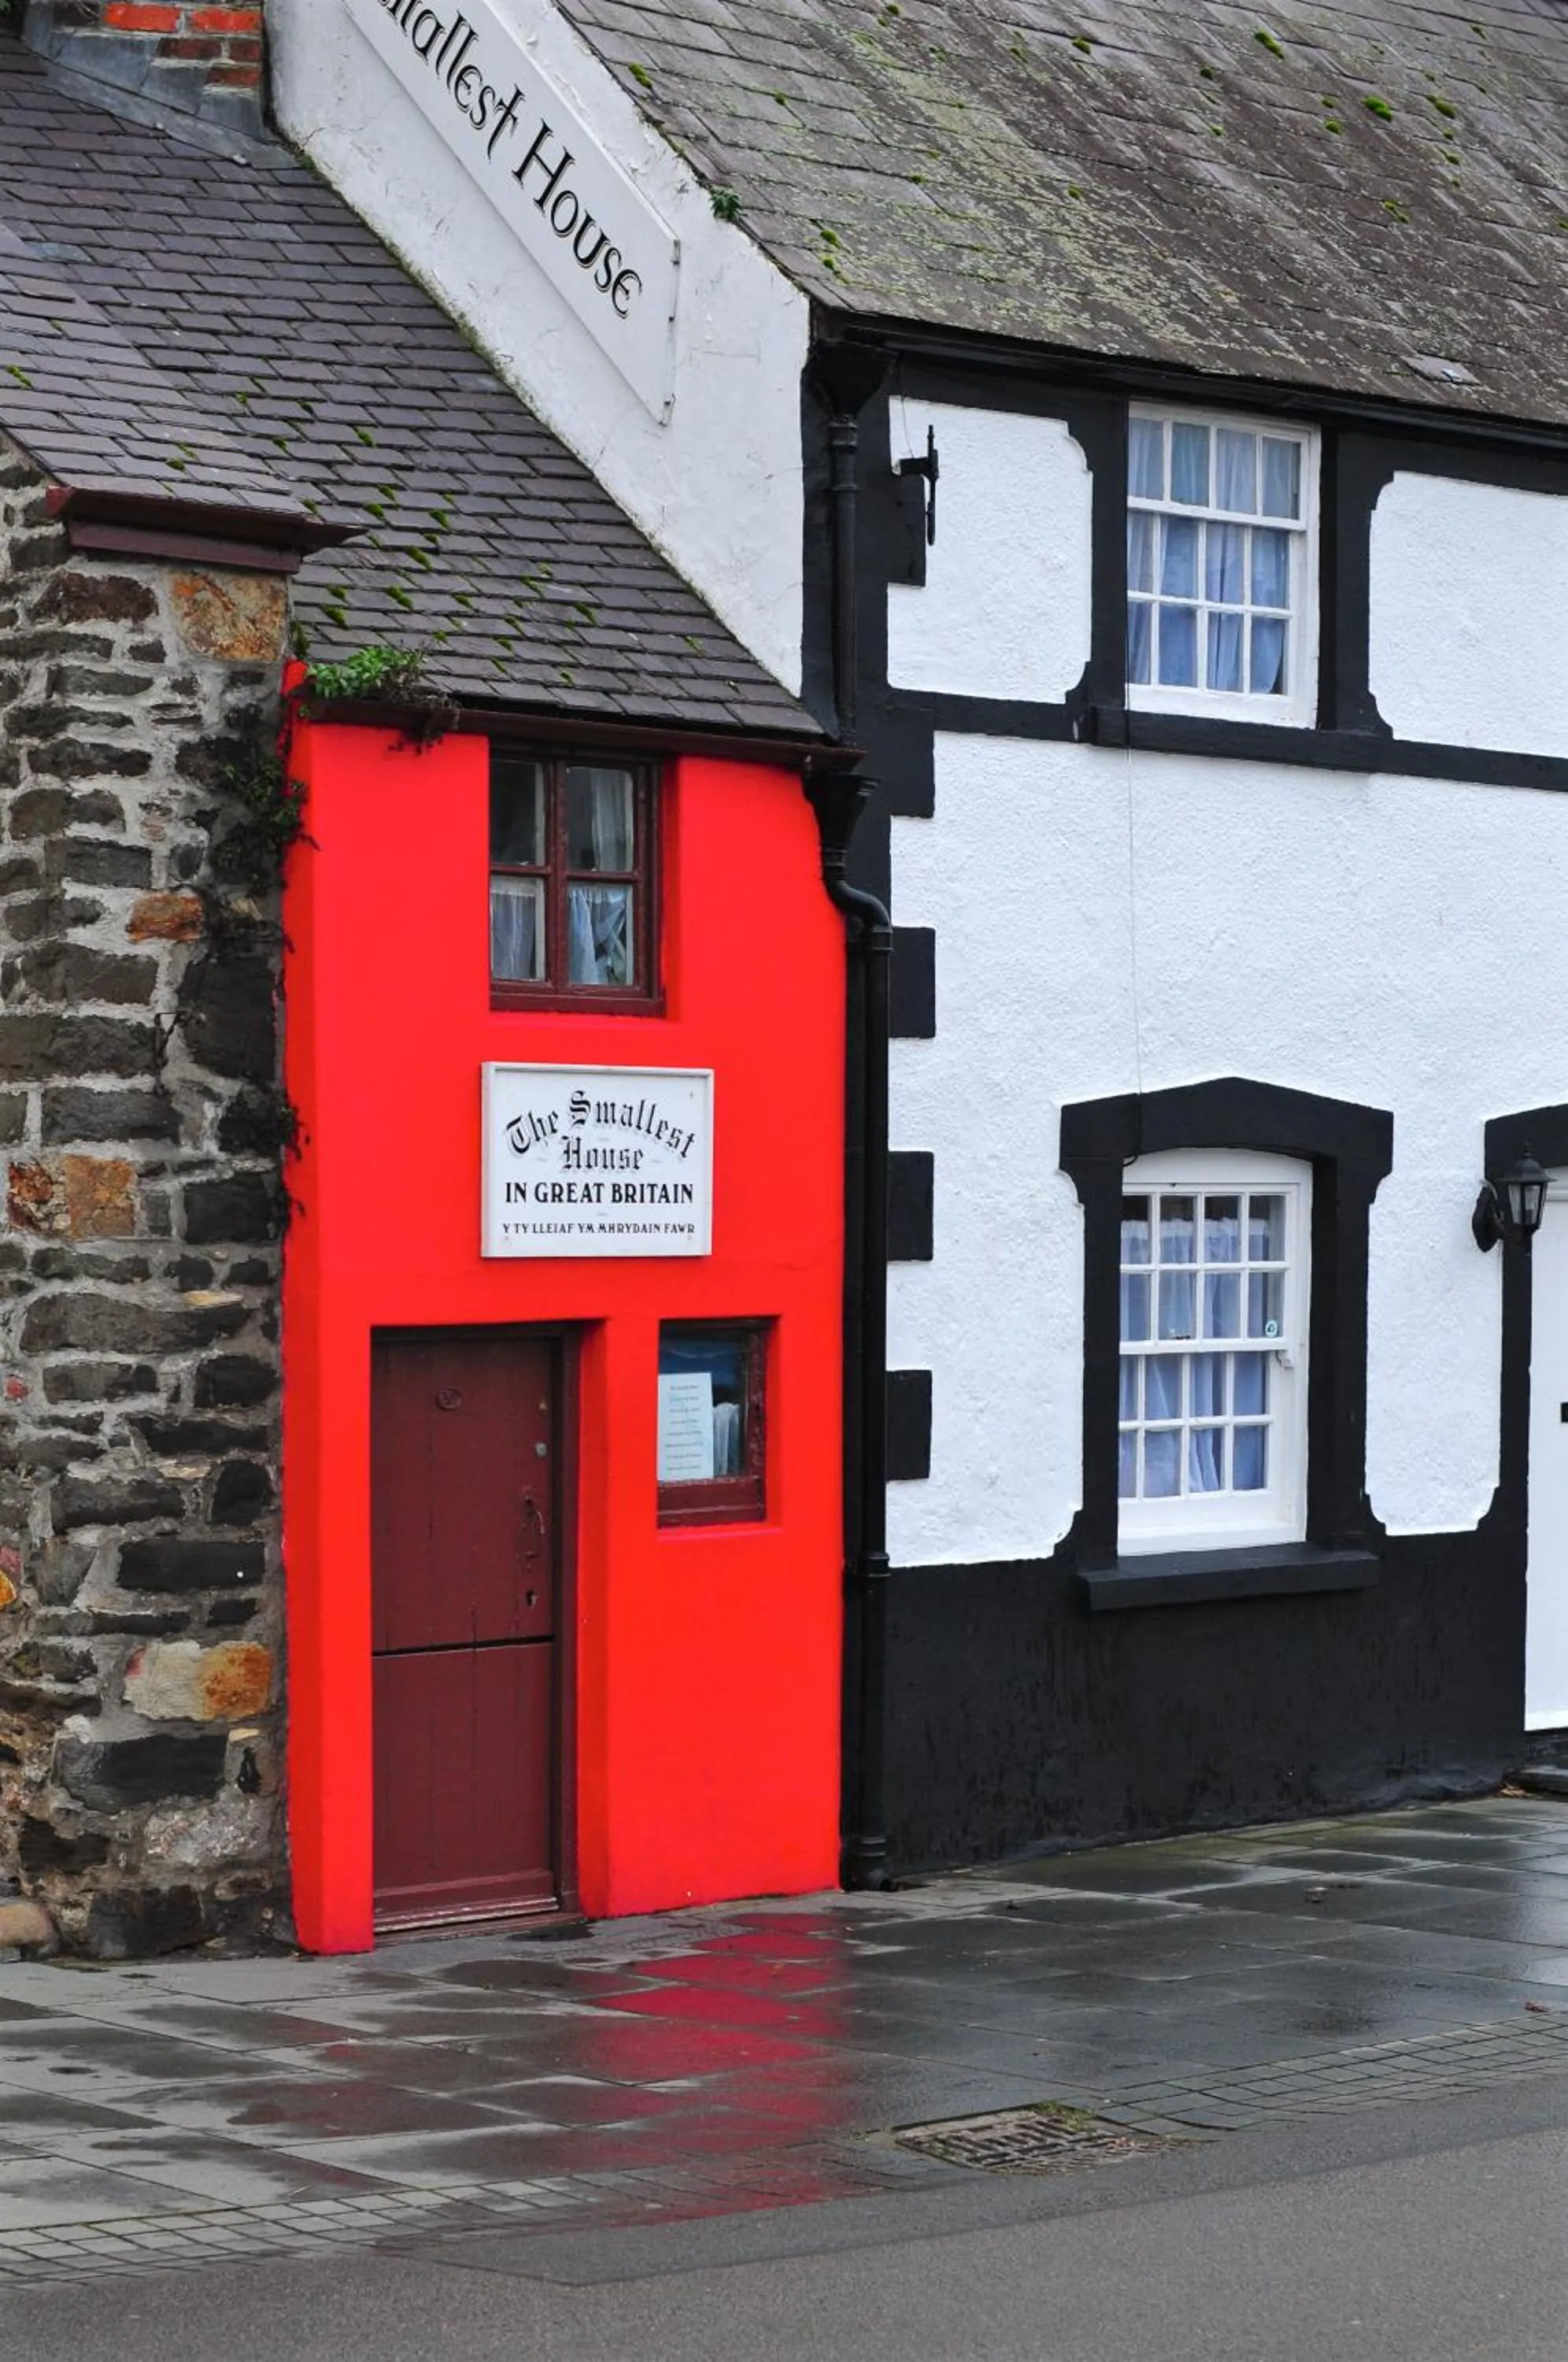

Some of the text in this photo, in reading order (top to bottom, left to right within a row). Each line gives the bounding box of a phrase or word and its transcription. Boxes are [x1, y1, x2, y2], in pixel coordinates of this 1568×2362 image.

[512, 119, 642, 319] House
[506, 1090, 695, 1158] The Smallest
[561, 1135, 644, 1170] House
[505, 1182, 693, 1205] IN GREAT BRITAIN
[502, 1223, 696, 1234] Y TY LLEIAF YM MHRYDAIN FAWR
